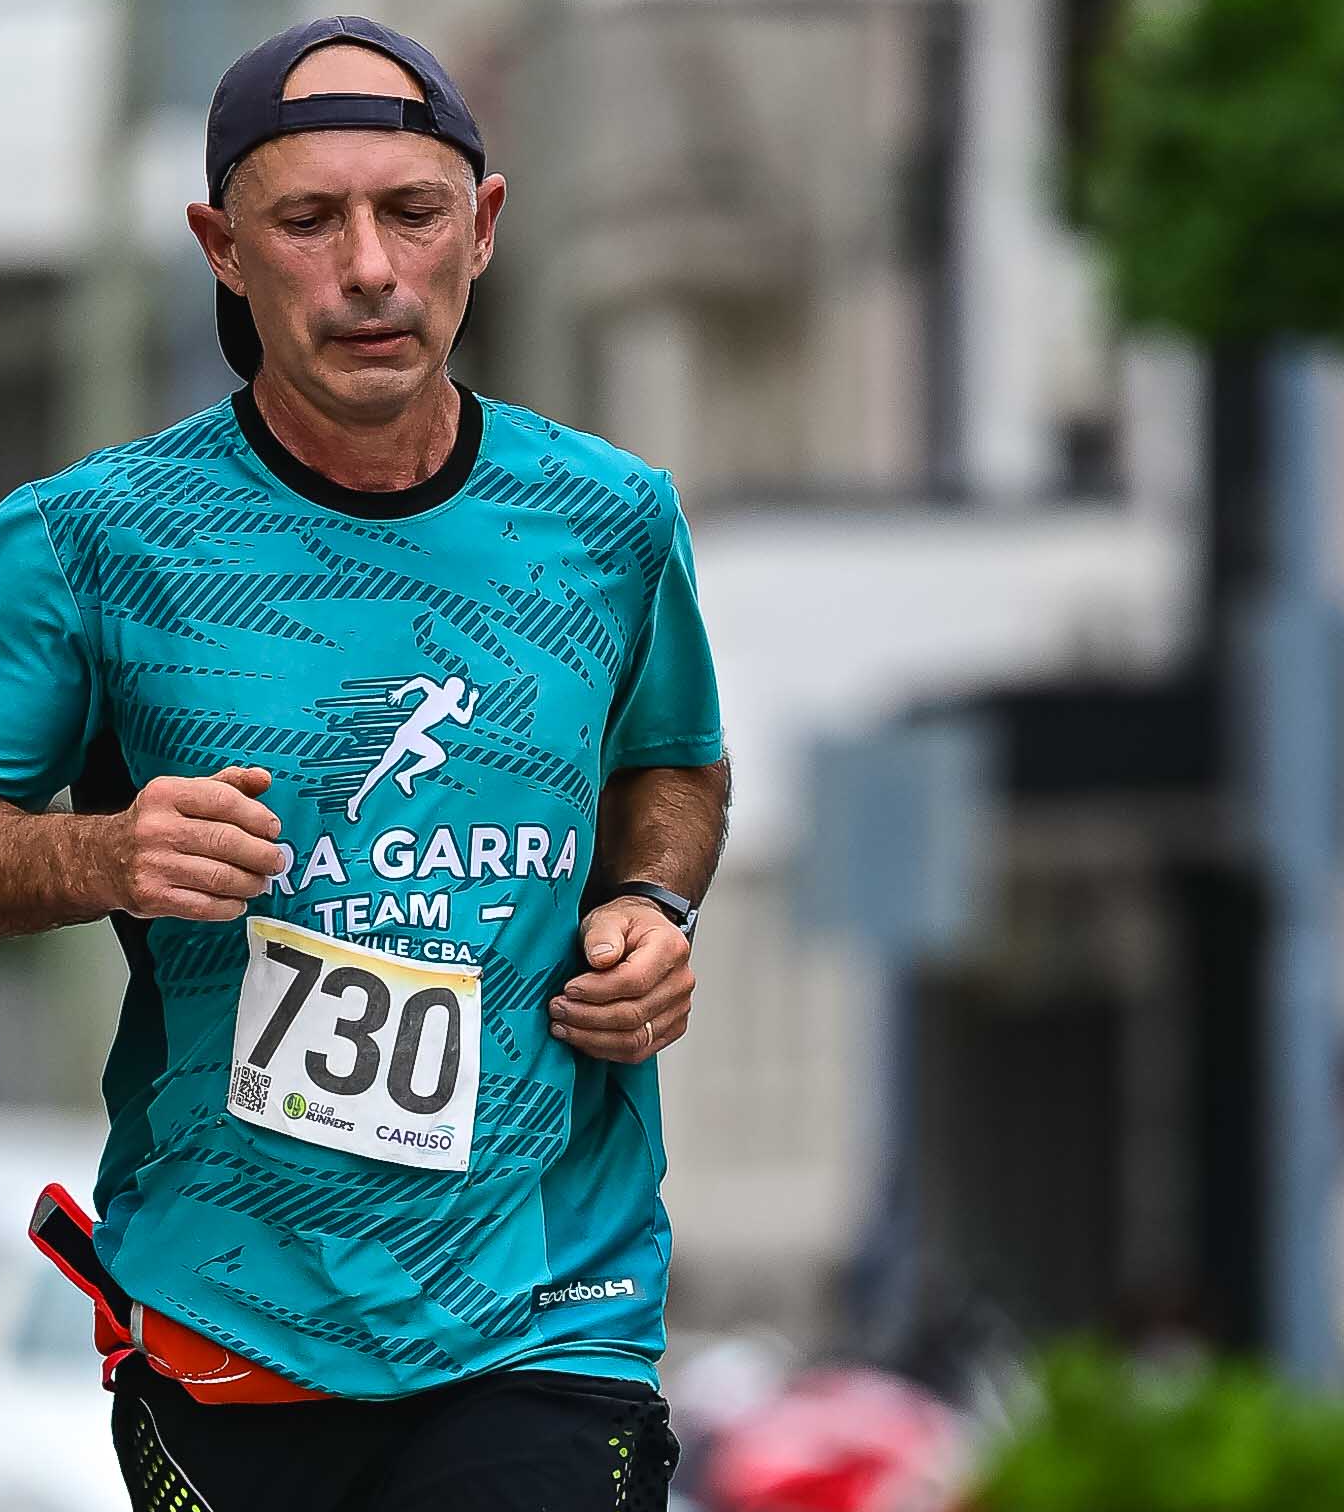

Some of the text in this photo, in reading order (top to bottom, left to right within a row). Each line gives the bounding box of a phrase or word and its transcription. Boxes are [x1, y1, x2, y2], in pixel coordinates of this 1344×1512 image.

[372, 826, 575, 879] GARRA
[315, 891, 448, 936] TEAM
[423, 941, 478, 964] CBA.
[248, 940, 460, 1115] 730
[308, 1102, 335, 1116] CLUB
[376, 1125, 452, 1150] CARUSO
